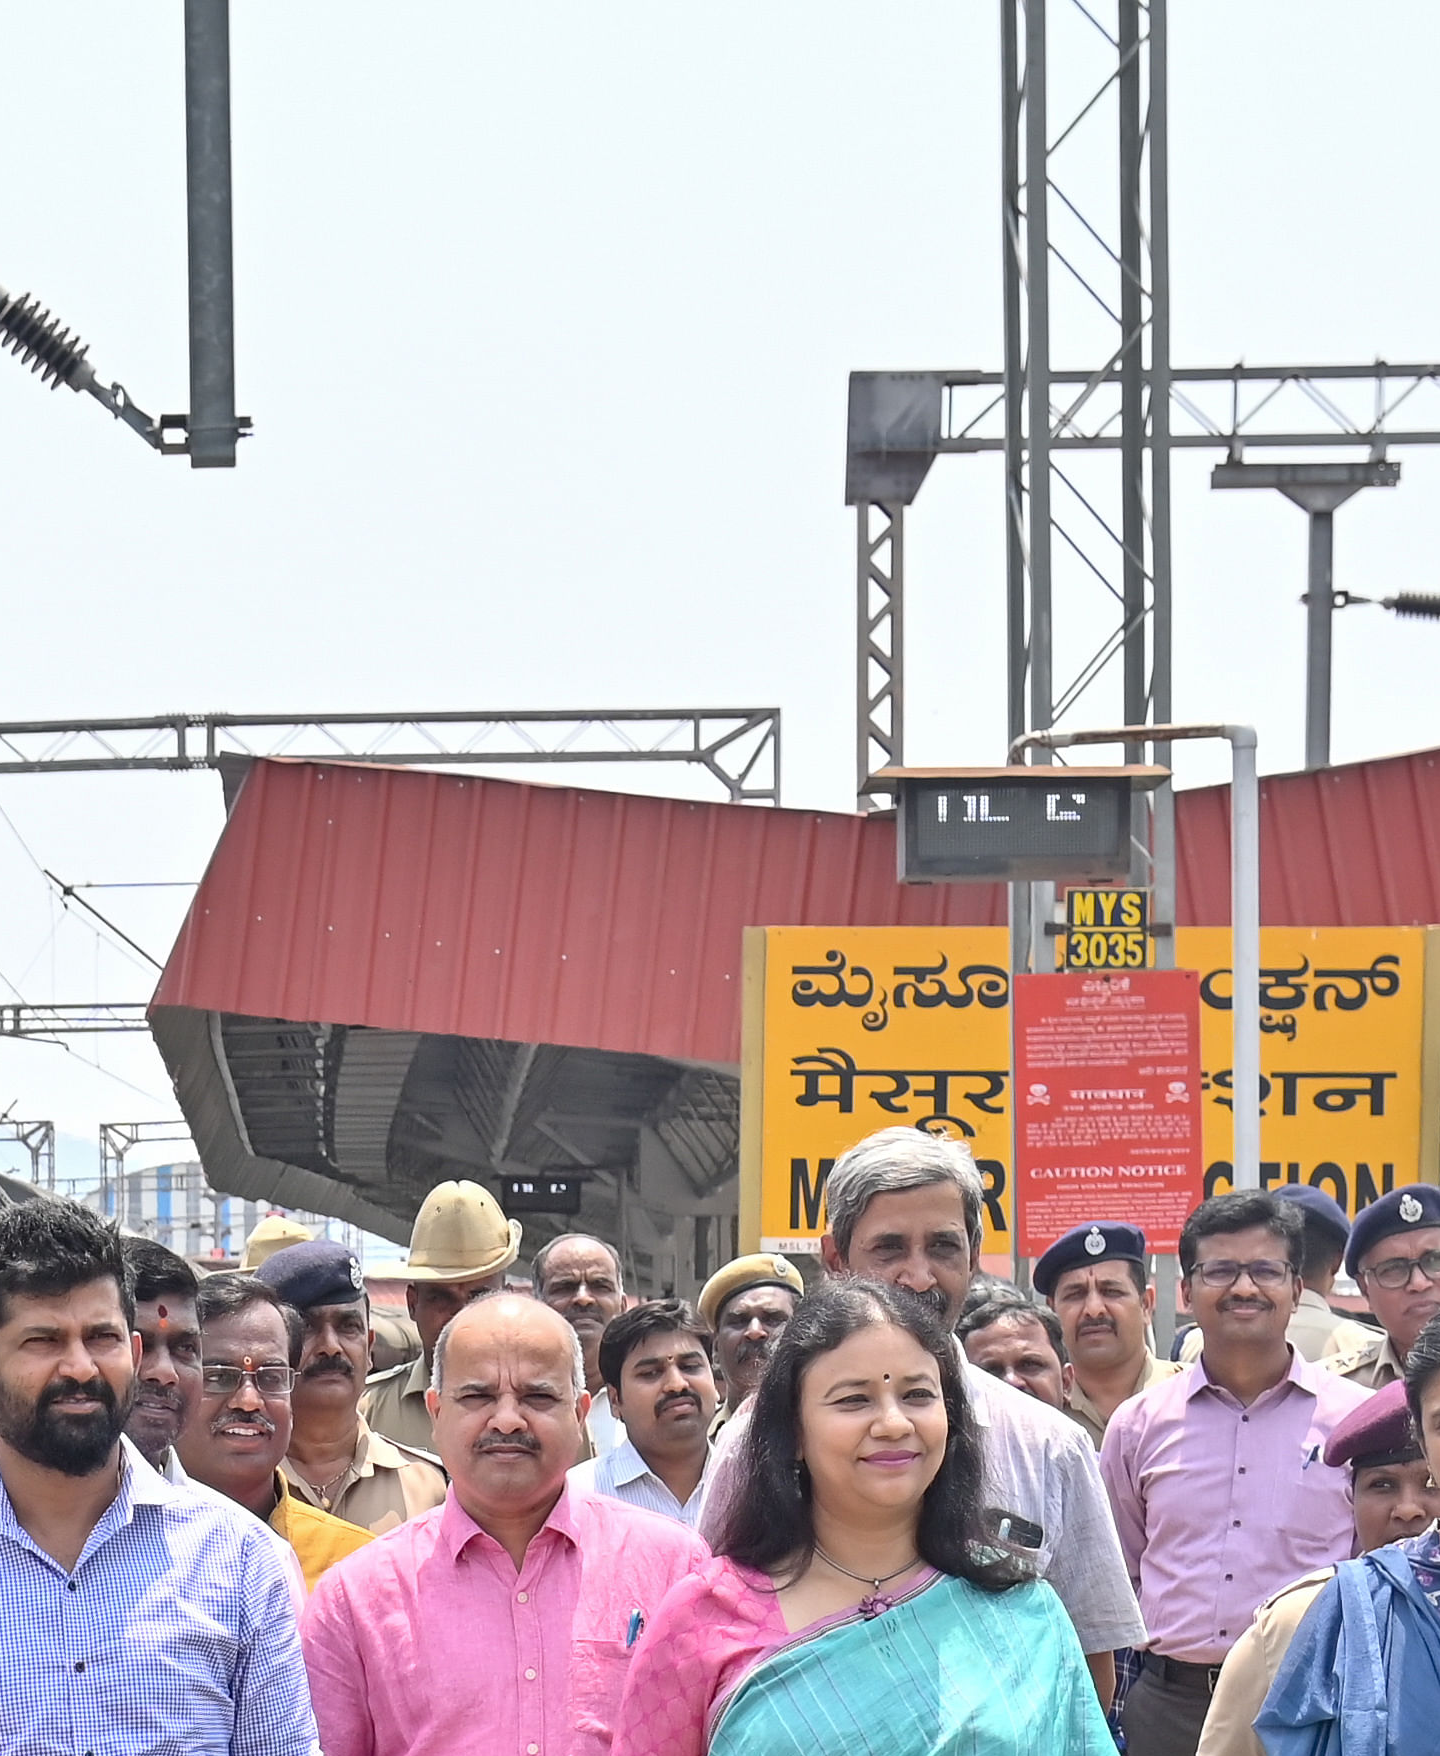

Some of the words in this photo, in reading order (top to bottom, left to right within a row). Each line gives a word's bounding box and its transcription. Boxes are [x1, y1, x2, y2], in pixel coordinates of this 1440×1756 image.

[1073, 893, 1142, 926] MYS
[1070, 933, 1144, 967] 3035
[792, 950, 1009, 1031] ಮೈಸೂ
[1030, 1165, 1114, 1179] CAUTION
[1118, 1164, 1187, 1177] NOTICE
